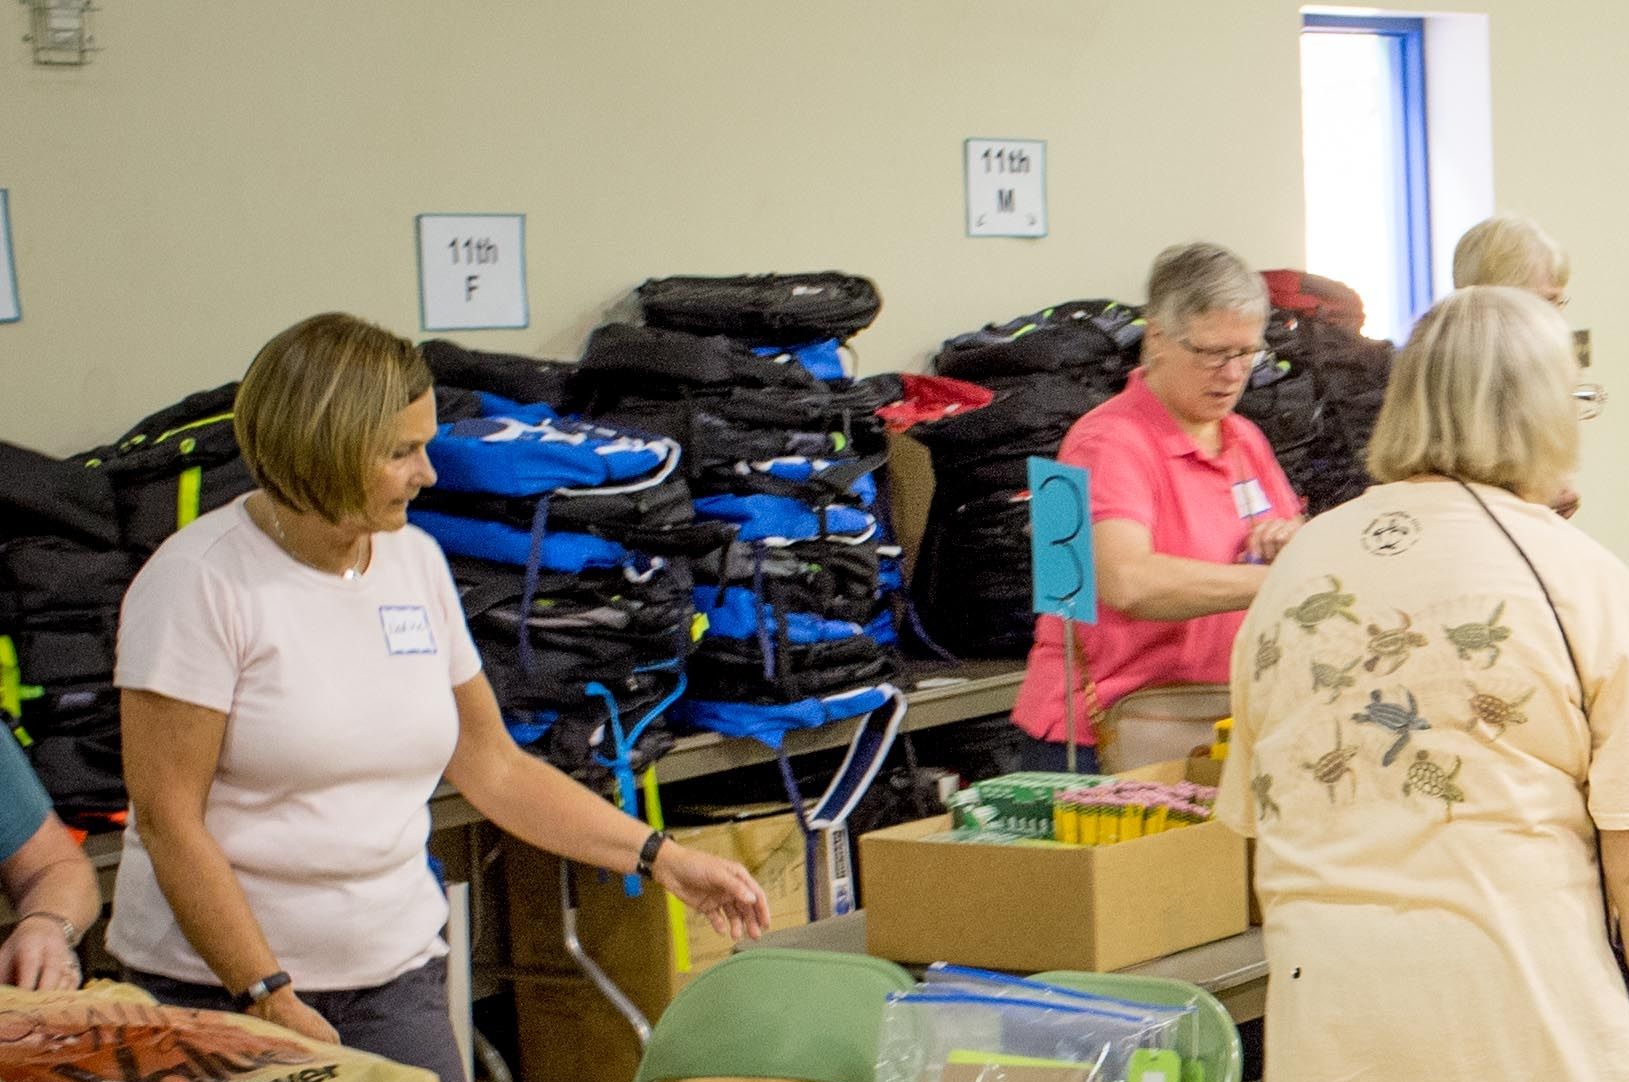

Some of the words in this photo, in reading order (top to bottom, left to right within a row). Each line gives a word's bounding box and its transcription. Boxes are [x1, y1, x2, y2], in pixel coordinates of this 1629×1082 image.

[981, 148, 1030, 174] 11th
[997, 188, 1015, 213] M
[449, 237, 498, 264] 11th
[465, 275, 478, 302] F
[1038, 475, 1084, 602] 3
